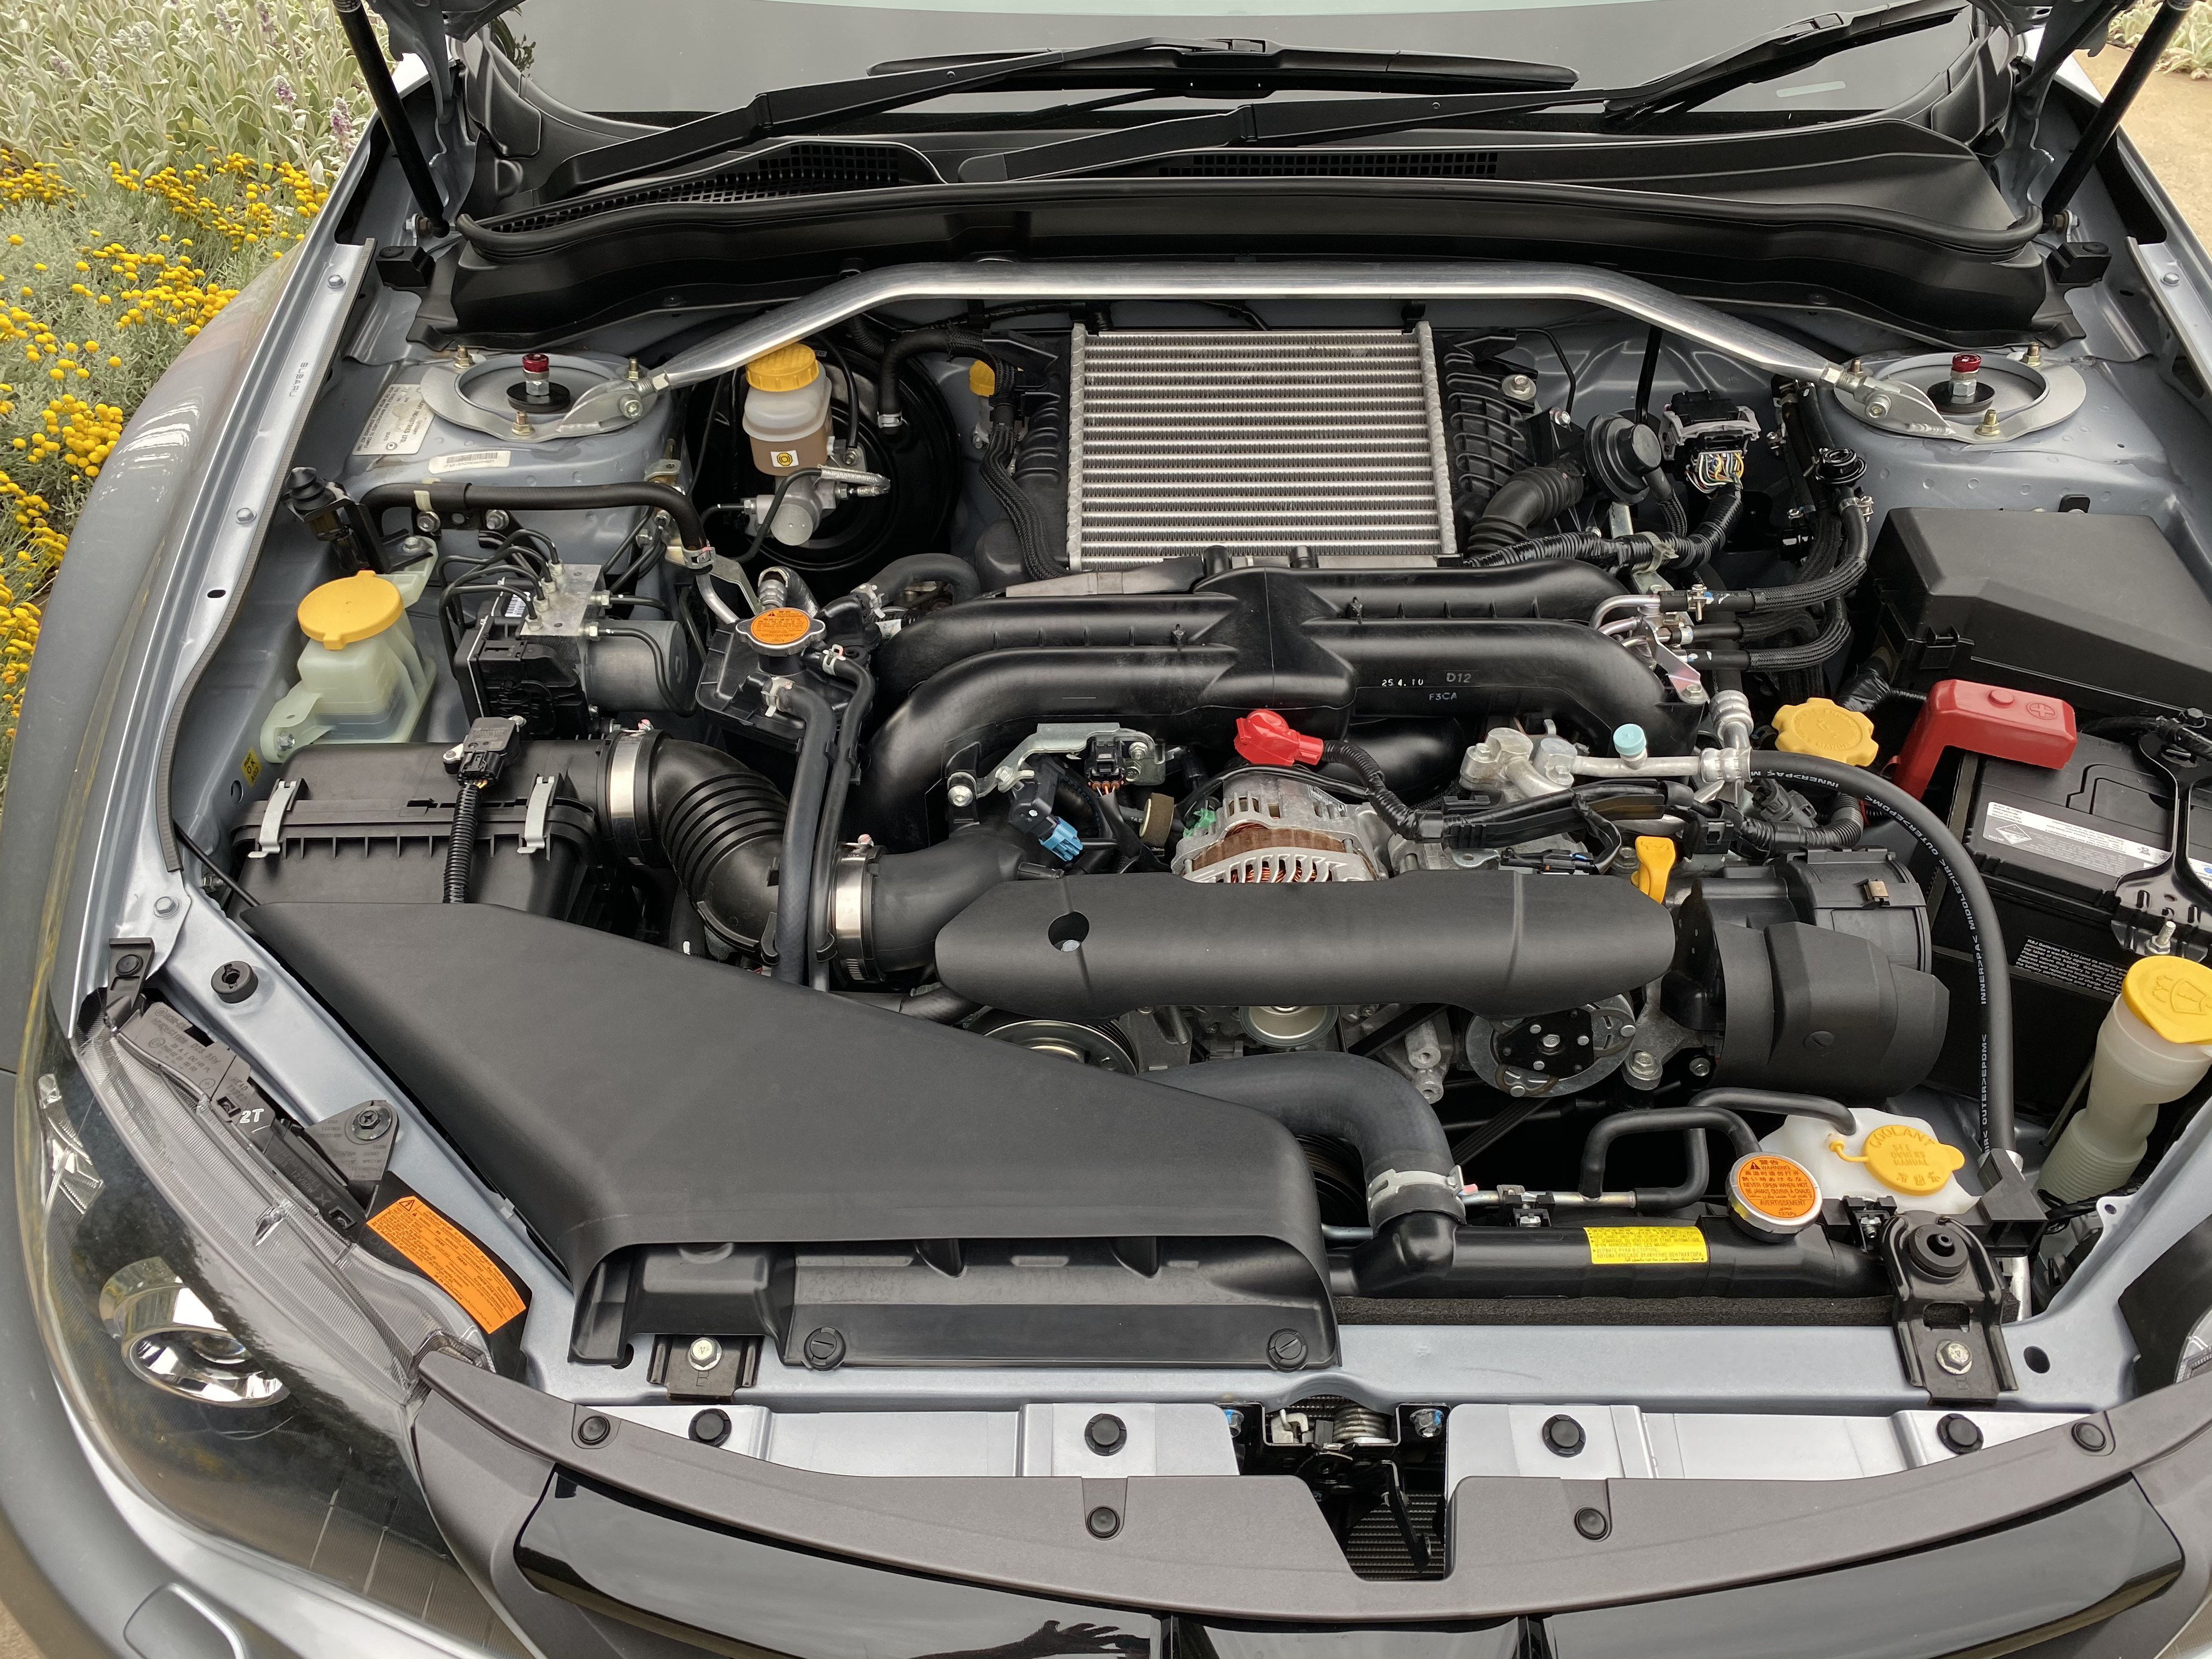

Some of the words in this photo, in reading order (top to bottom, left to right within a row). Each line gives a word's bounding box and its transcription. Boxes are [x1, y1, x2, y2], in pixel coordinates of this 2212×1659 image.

[289, 361, 308, 398] SUBARU
[404, 410, 419, 433] INDUSTRIES
[1446, 673, 1471, 682] D12
[2025, 943, 2046, 952] provides
[2051, 951, 2072, 960] warranty
[2073, 958, 2091, 966] against
[2039, 943, 2060, 952] Batteries
[2017, 958, 2039, 967] Batteries
[2049, 967, 2067, 975] replace
[2038, 960, 2059, 969] warranty
[2083, 965, 2105, 974] Warranty
[2042, 970, 2073, 981] performance
[2092, 985, 2114, 995] agreeing
[230, 1075, 249, 1092] HEAD
[1870, 1126, 1936, 1149] COOLANT
[1893, 1157, 1931, 1167] MANUAL
